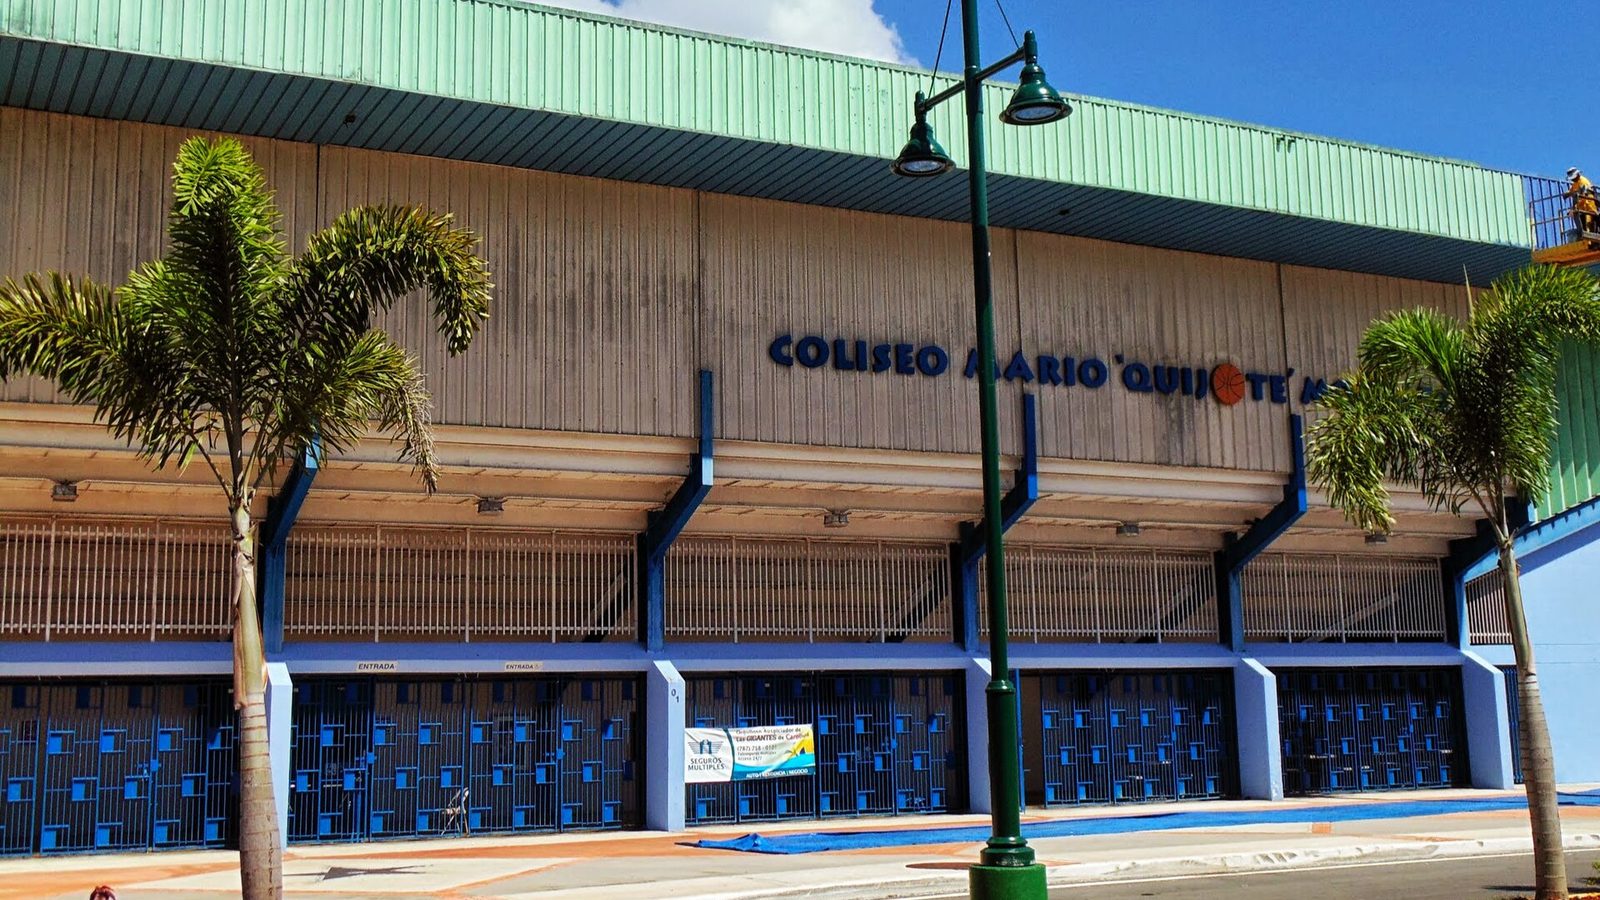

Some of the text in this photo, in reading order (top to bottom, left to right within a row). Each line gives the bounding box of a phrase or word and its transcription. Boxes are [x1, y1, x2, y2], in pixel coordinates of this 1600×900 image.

[769, 335, 948, 376] COLISEO
[746, 733, 777, 741] GIGANTES
[688, 763, 725, 771] MULTIPLES
